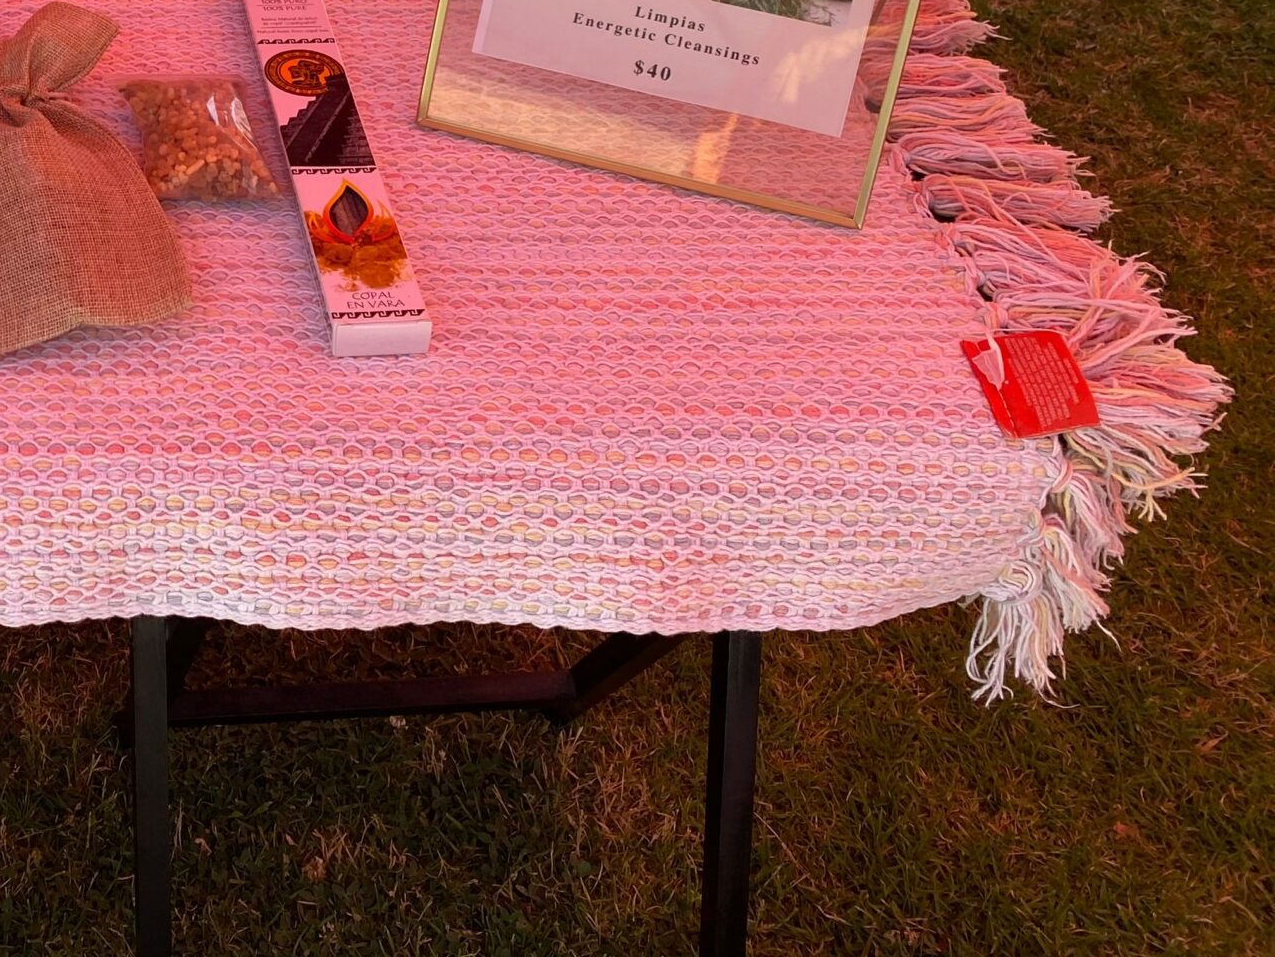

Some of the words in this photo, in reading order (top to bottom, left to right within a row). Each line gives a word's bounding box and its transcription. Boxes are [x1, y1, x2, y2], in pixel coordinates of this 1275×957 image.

[634, 5, 706, 33] Limpias
[573, 12, 657, 42] Energetic
[664, 33, 761, 67] Cleansings
[632, 59, 673, 82] $40
[346, 301, 365, 310] EN
[367, 299, 405, 309] VARA
[351, 291, 395, 300] COPAL
